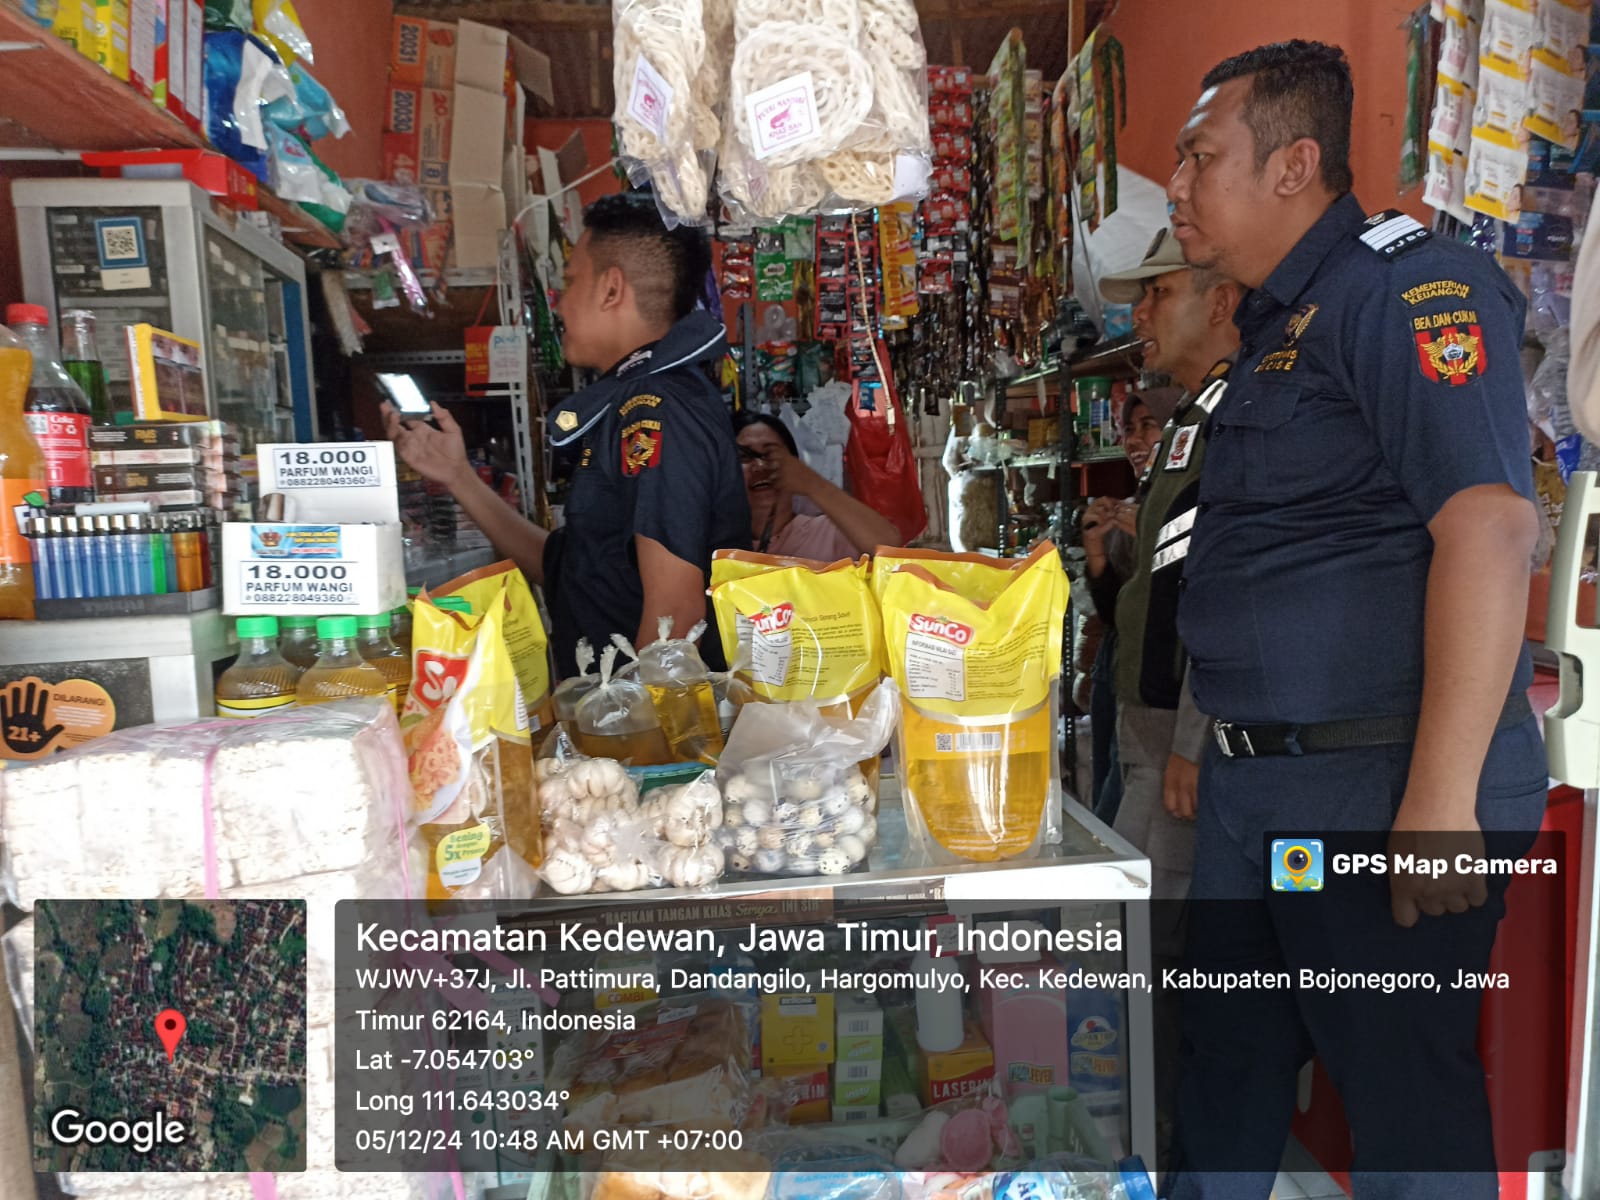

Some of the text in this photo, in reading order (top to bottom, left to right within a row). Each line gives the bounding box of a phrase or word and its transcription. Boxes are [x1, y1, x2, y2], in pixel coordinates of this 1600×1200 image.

[401, 23, 419, 65] 20031
[393, 90, 414, 133] 20030
[1401, 280, 1471, 299] KEMENTERIAN
[1409, 287, 1470, 305] KEUANGAN
[1413, 309, 1478, 331] BEA DAN CUKAI
[280, 451, 367, 465] 18.000
[280, 465, 373, 477] PARFUM WANGI
[248, 565, 347, 579] 18.000
[246, 582, 353, 593] PARFUM WANGI
[910, 615, 968, 643] SunCo
[8, 725, 42, 743] 21+
[657, 907, 701, 923] TANGAN
[703, 904, 732, 919] KHAS
[735, 902, 778, 918] Surya
[607, 991, 645, 1003] COMBI
